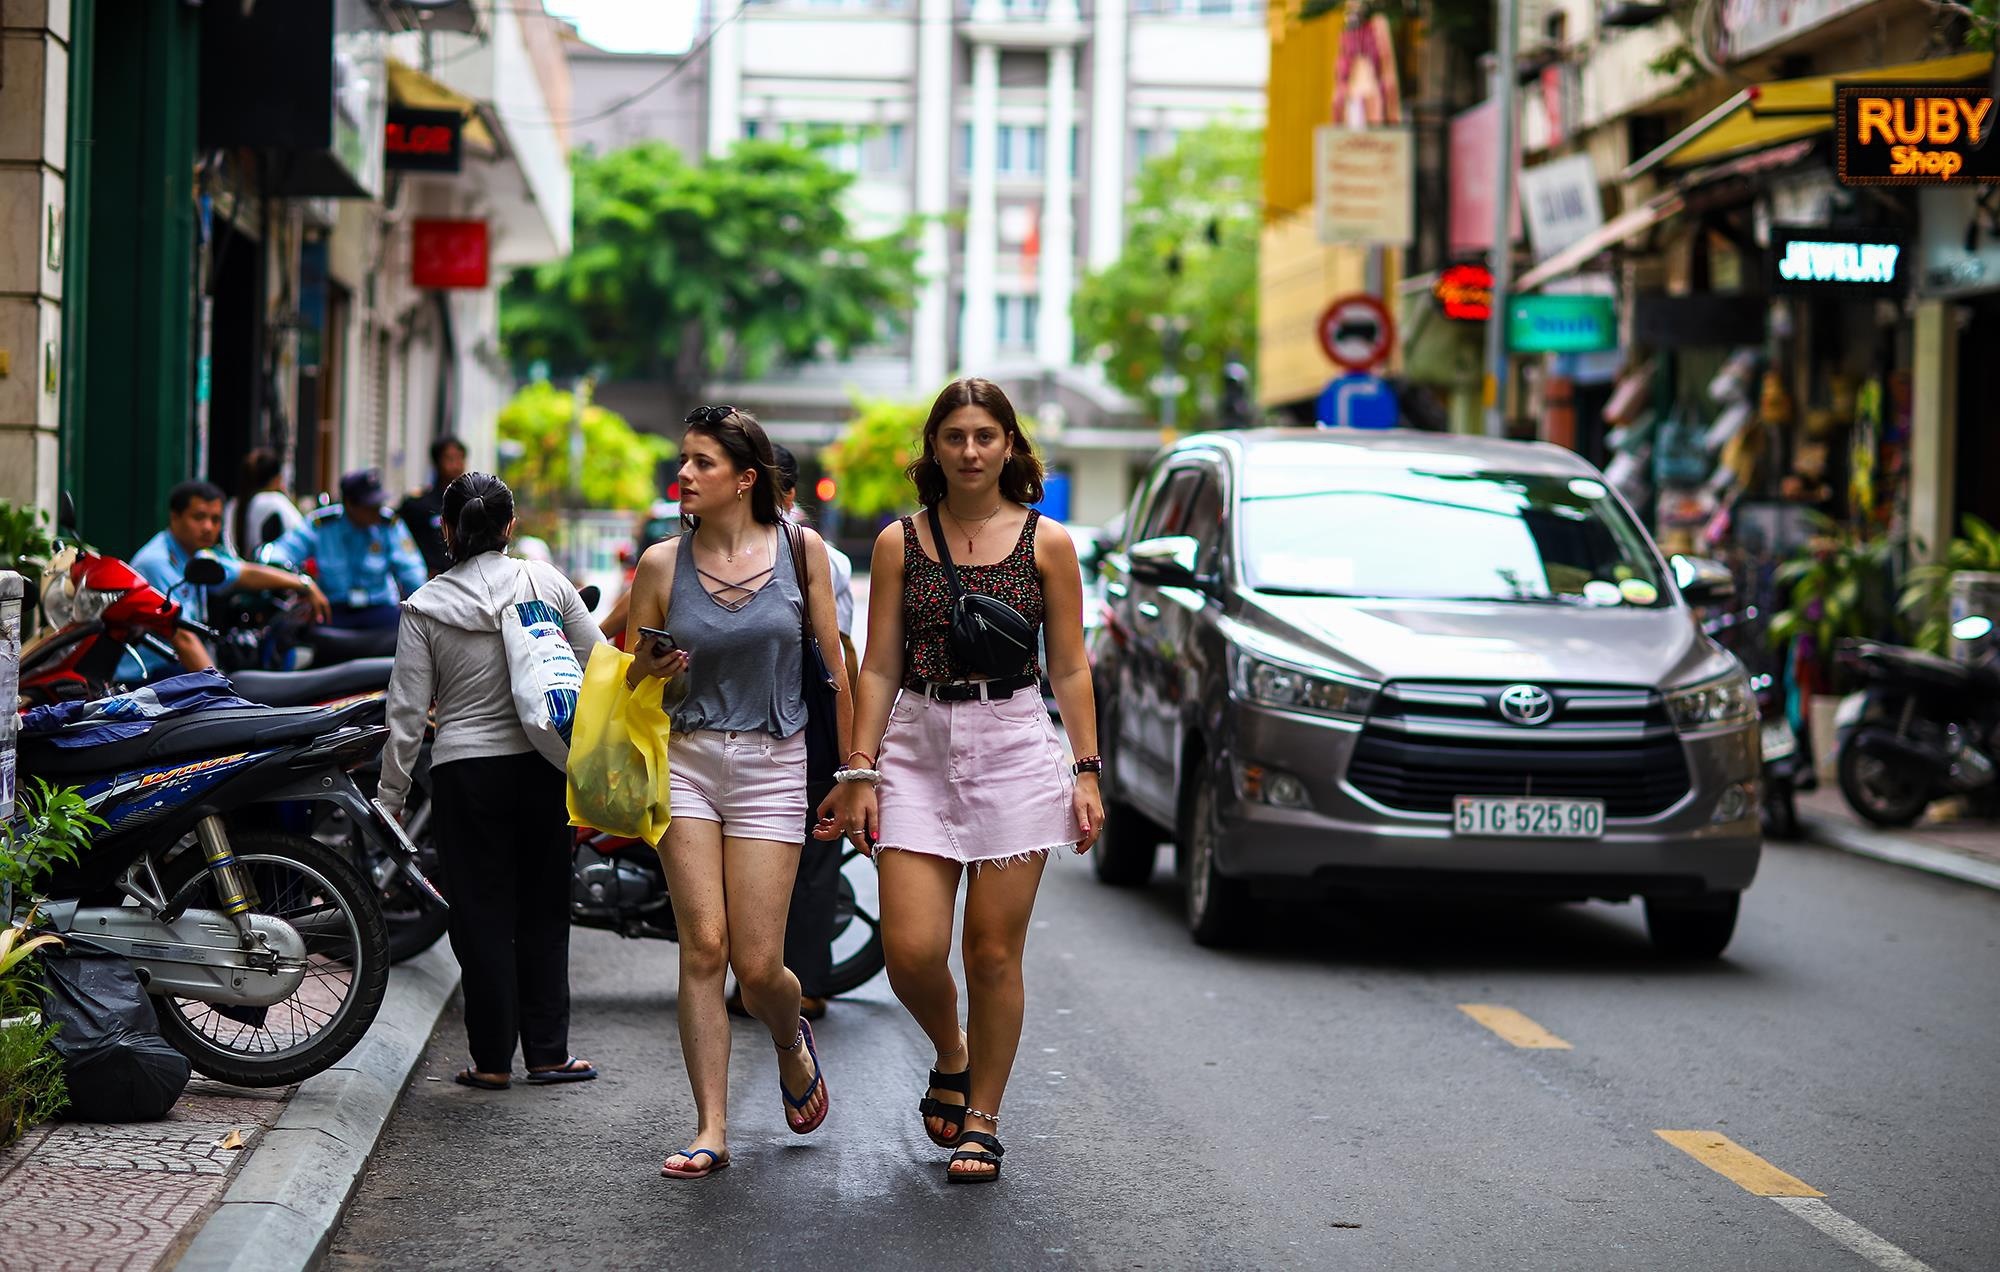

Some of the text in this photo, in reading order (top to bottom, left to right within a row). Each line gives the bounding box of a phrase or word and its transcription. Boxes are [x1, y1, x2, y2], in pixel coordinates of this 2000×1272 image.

[1858, 97, 1993, 145] RUBY
[1890, 145, 1963, 181] Shop
[1779, 240, 1899, 282] JEWELRY
